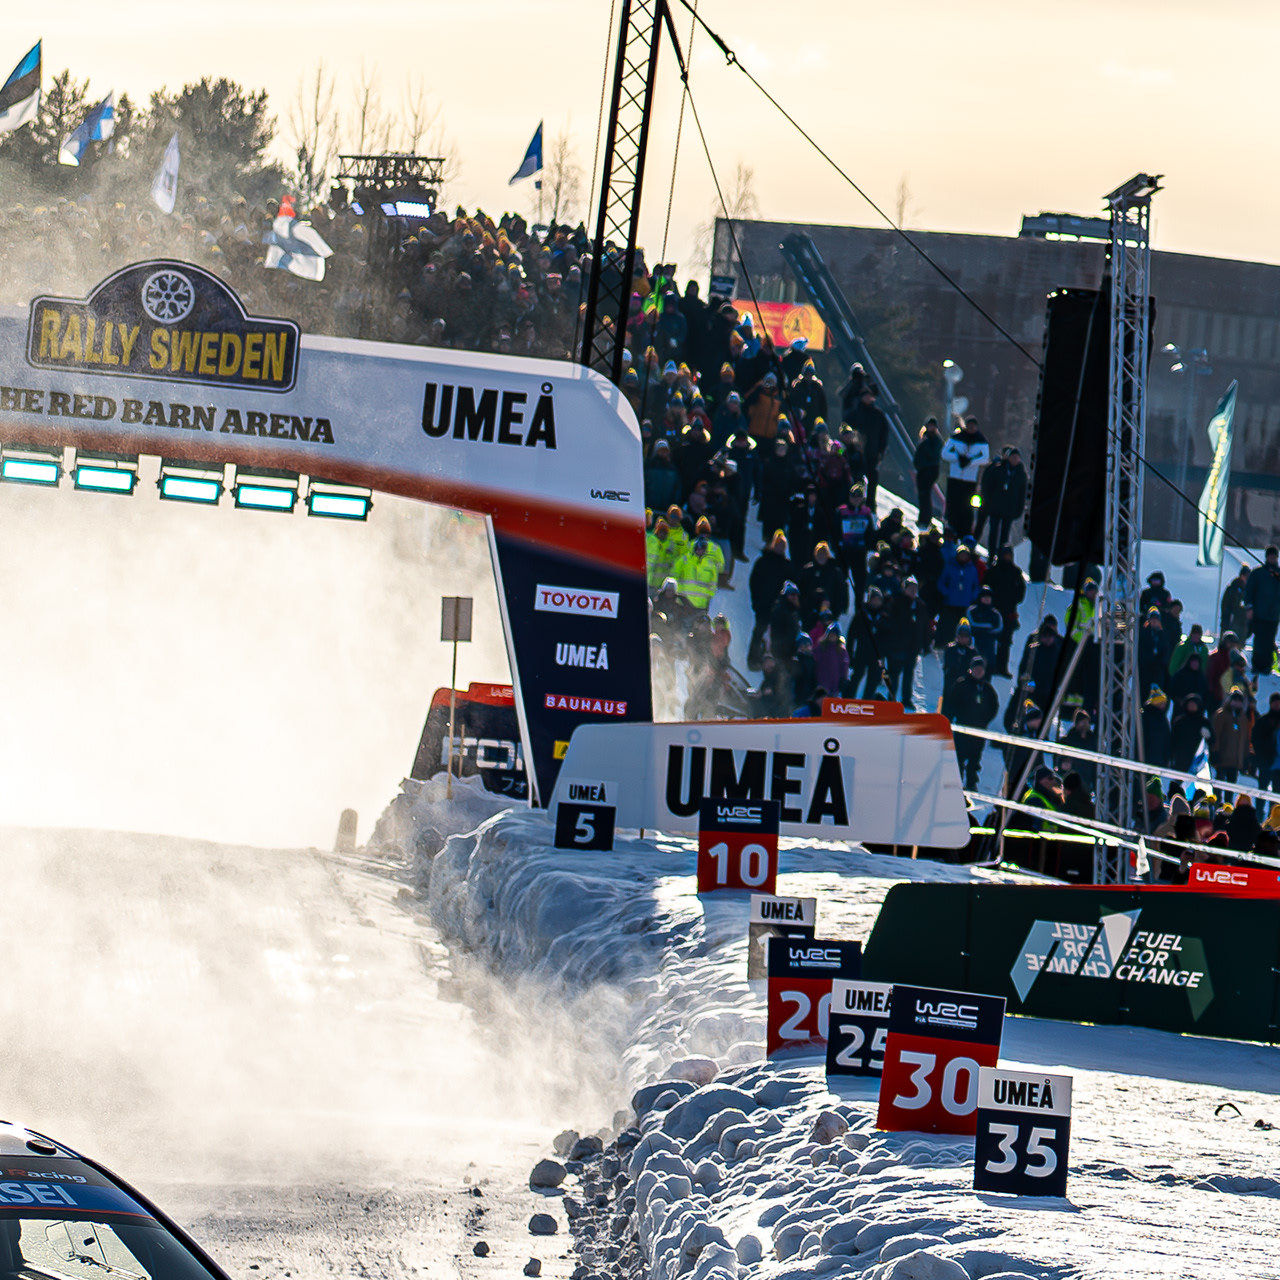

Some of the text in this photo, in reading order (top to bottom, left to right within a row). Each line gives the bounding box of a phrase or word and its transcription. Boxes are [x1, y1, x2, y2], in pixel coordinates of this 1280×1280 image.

[39, 308, 288, 382] RALLY SWEDEN
[47, 391, 117, 421] RED
[120, 398, 217, 432] BARN
[220, 408, 335, 444] ARENA
[421, 381, 558, 450] UMEÅ
[590, 488, 631, 503] WRC
[541, 591, 613, 612] TOYOTA
[555, 642, 609, 670] UMEÅ
[546, 696, 627, 715] BAUHAUS
[830, 703, 875, 716] WRC
[570, 782, 606, 802] UMEÅ
[666, 738, 849, 826] UMEÅ
[717, 806, 762, 818] WRC
[574, 812, 595, 843] 5
[708, 842, 769, 887] 10
[1195, 868, 1249, 886] WRC
[761, 900, 804, 921] UMEÅ
[1132, 931, 1183, 952] FUEL
[789, 947, 842, 961] WRC
[1124, 948, 1170, 967] FOR
[1115, 965, 1204, 989] CHANGE
[915, 999, 979, 1020] WRC
[835, 1024, 889, 1070] 25
[892, 1050, 981, 1117] 30
[993, 1078, 1054, 1110] UMEÅ
[985, 1122, 1058, 1178] 35
[8, 1168, 88, 1184] Racing
